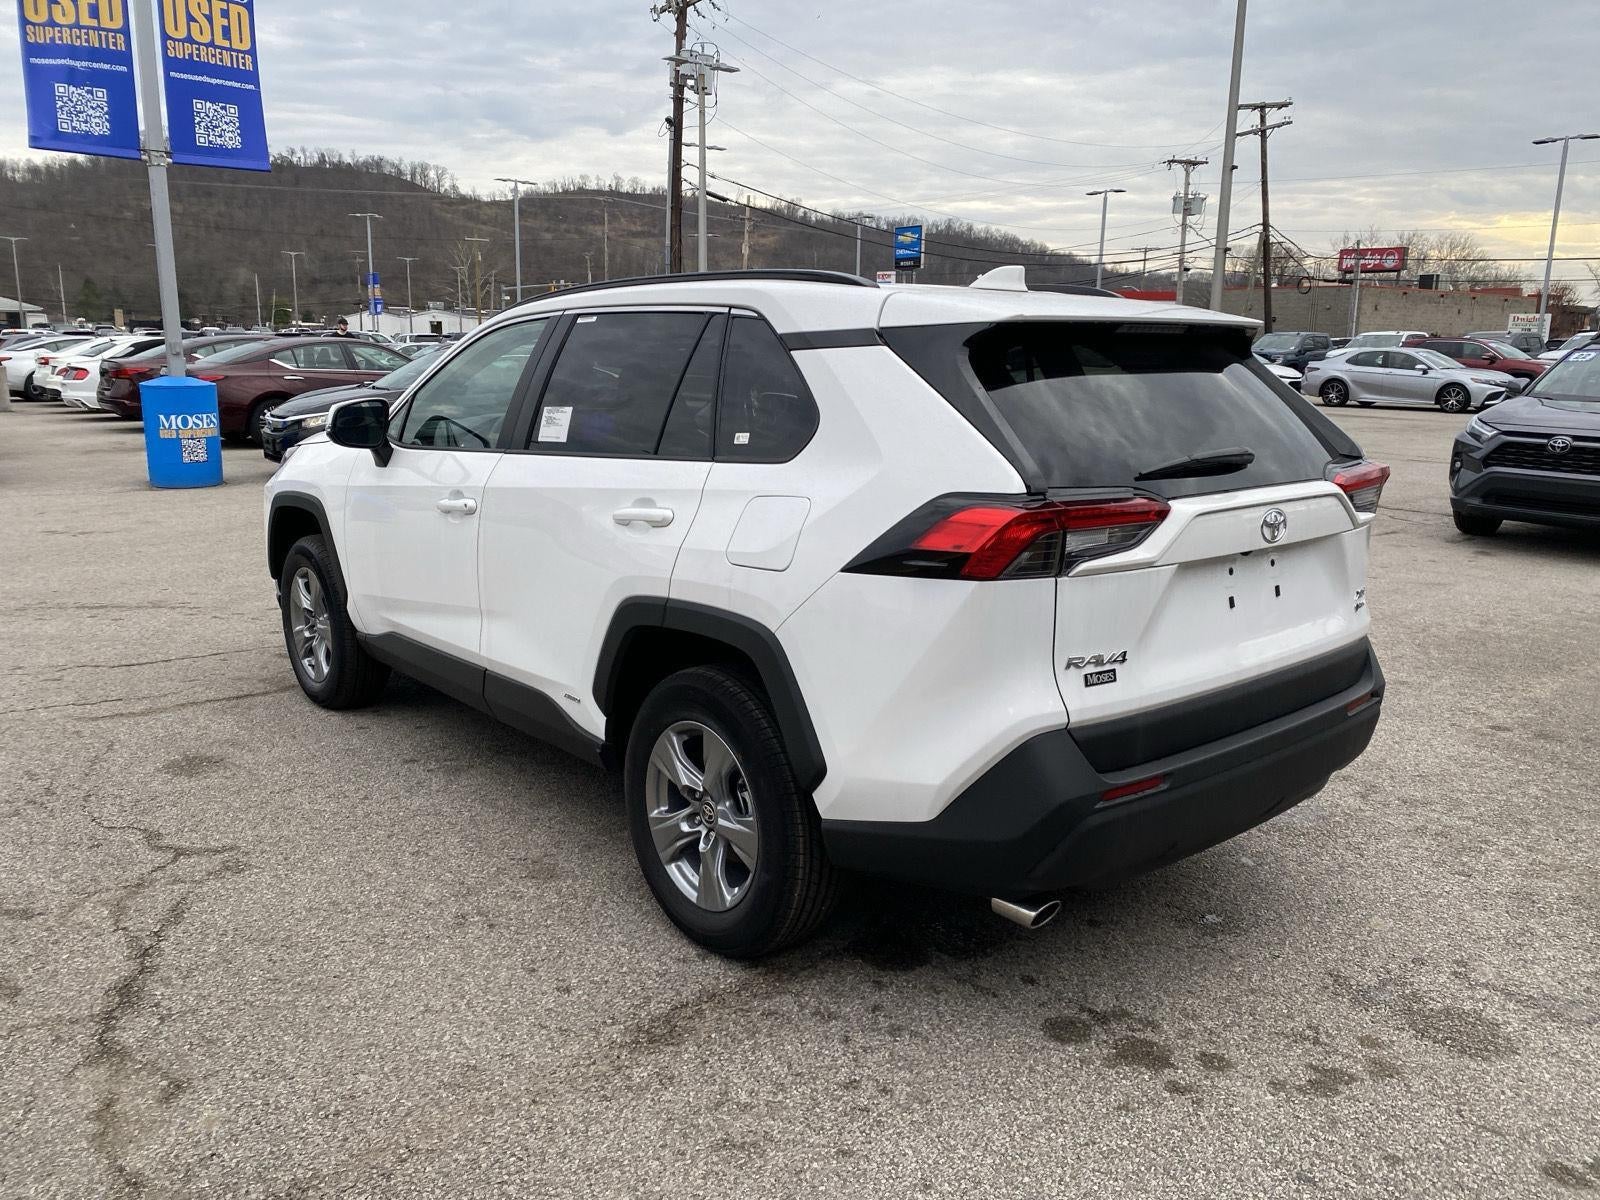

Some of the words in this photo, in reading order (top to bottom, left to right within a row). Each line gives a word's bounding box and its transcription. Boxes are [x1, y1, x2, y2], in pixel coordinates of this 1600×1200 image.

[163, 0, 251, 50] USED
[26, 24, 126, 51] SUPERCENTER
[29, 57, 128, 72] mosesusedsupercenter.com
[166, 39, 253, 71] SUPERCENTER
[169, 71, 255, 90] mosesusedsupercenter.com
[1342, 251, 1381, 269] Wdy's
[158, 413, 218, 430] MOSES
[1064, 650, 1128, 671] RAV4
[1086, 671, 1115, 686] MOSES
